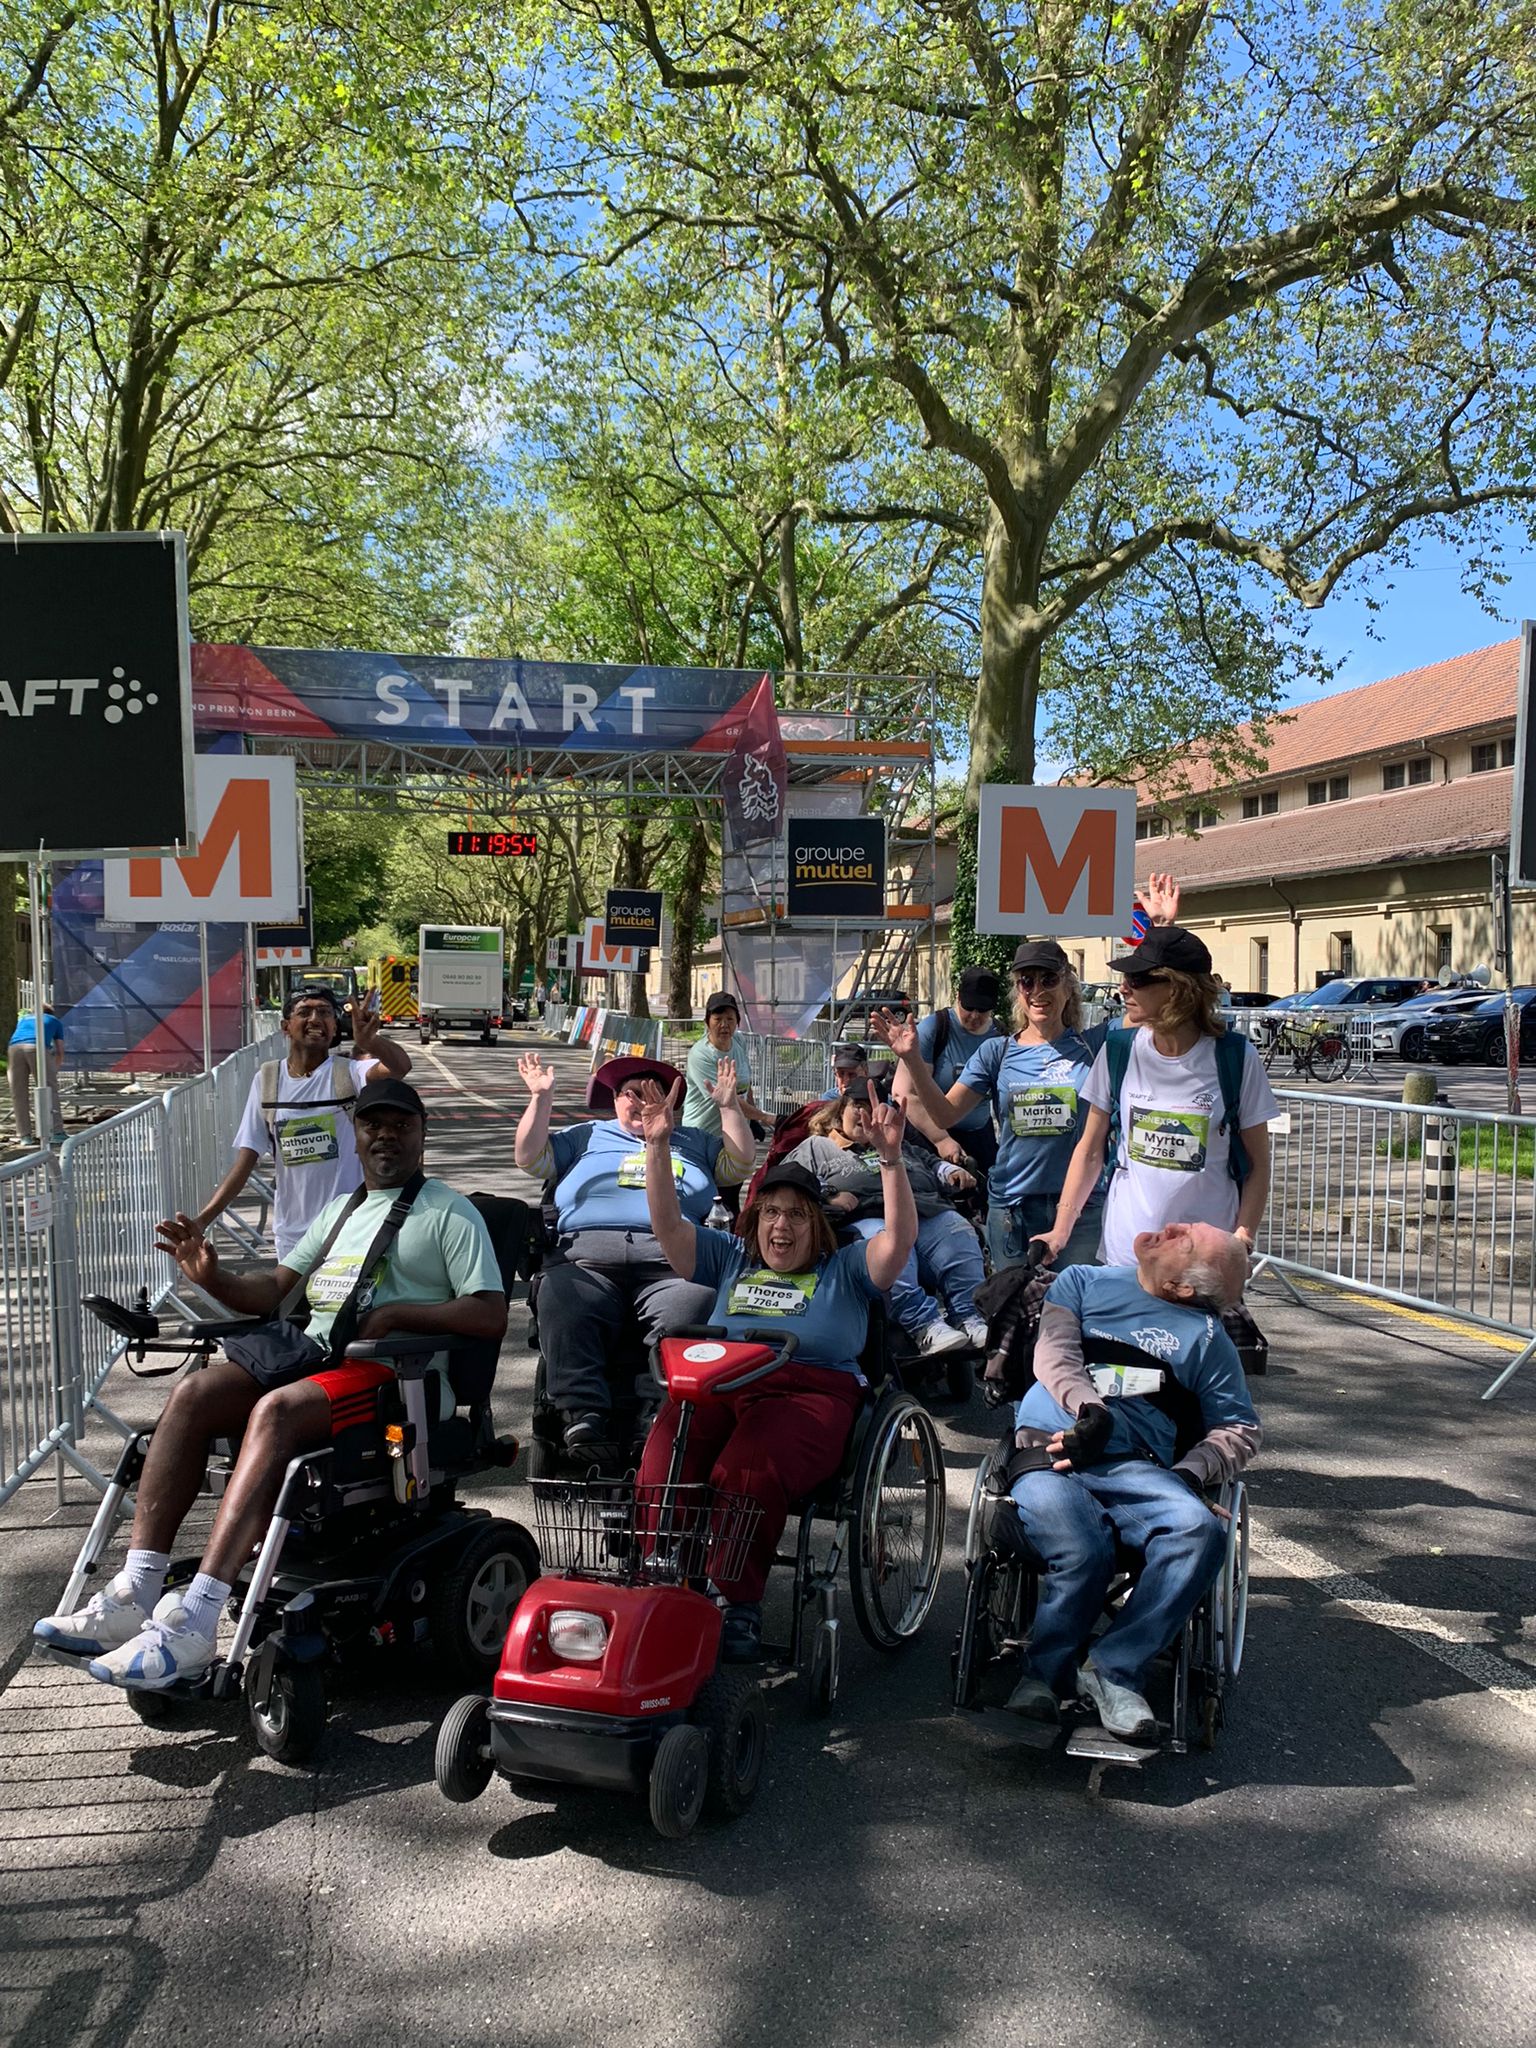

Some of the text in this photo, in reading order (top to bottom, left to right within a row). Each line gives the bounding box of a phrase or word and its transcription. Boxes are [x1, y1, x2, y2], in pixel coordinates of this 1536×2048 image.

[375, 674, 656, 734] START
[209, 704, 235, 714] PRIX
[239, 707, 263, 716] VON
[266, 709, 296, 717] BERN
[129, 779, 272, 897] M
[457, 834, 536, 855] 11:19:54
[795, 847, 865, 864] groupe
[999, 806, 1117, 916] M
[796, 863, 872, 879] mutuel
[610, 905, 651, 916] groupe
[610, 916, 655, 926] mutuel
[443, 933, 480, 943] Europcar
[1013, 1092, 1051, 1102] MIGROS
[1023, 1106, 1061, 1116] Marika
[1032, 1118, 1052, 1126] 7773
[1133, 1112, 1180, 1127] BERNEXPO
[1144, 1132, 1185, 1147] Myrta
[294, 1146, 315, 1156] 7760
[1151, 1147, 1175, 1158] 7766
[748, 1286, 792, 1299] Theres
[753, 1297, 779, 1308] 7764
[600, 1511, 626, 1519] BASIL
